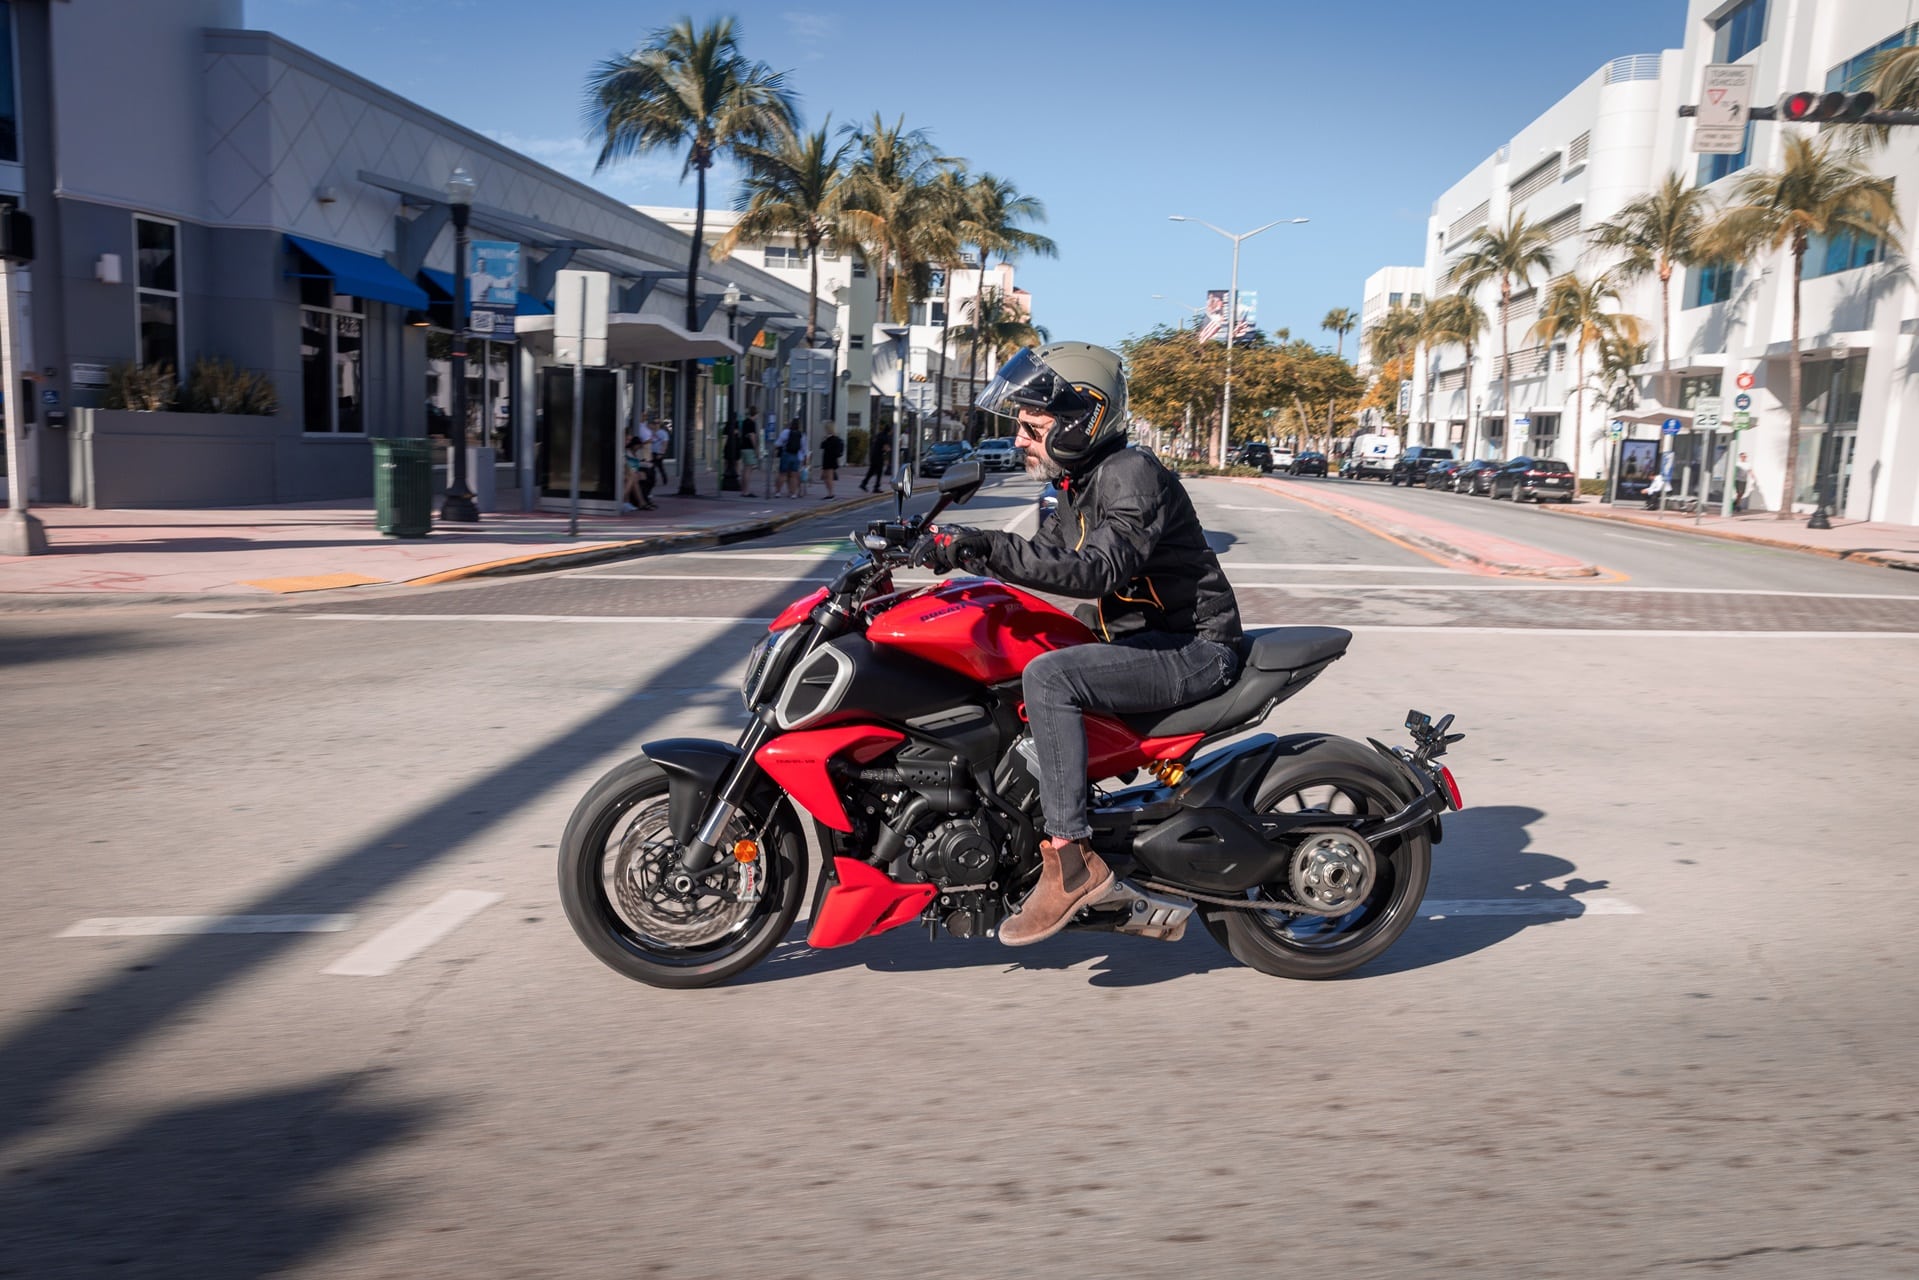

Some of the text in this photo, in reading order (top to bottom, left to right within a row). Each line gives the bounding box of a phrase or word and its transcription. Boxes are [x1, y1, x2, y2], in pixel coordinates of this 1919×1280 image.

[1085, 402, 1102, 436] DUCATI
[1695, 414, 1718, 426] 25
[920, 602, 966, 621] DUCATI
